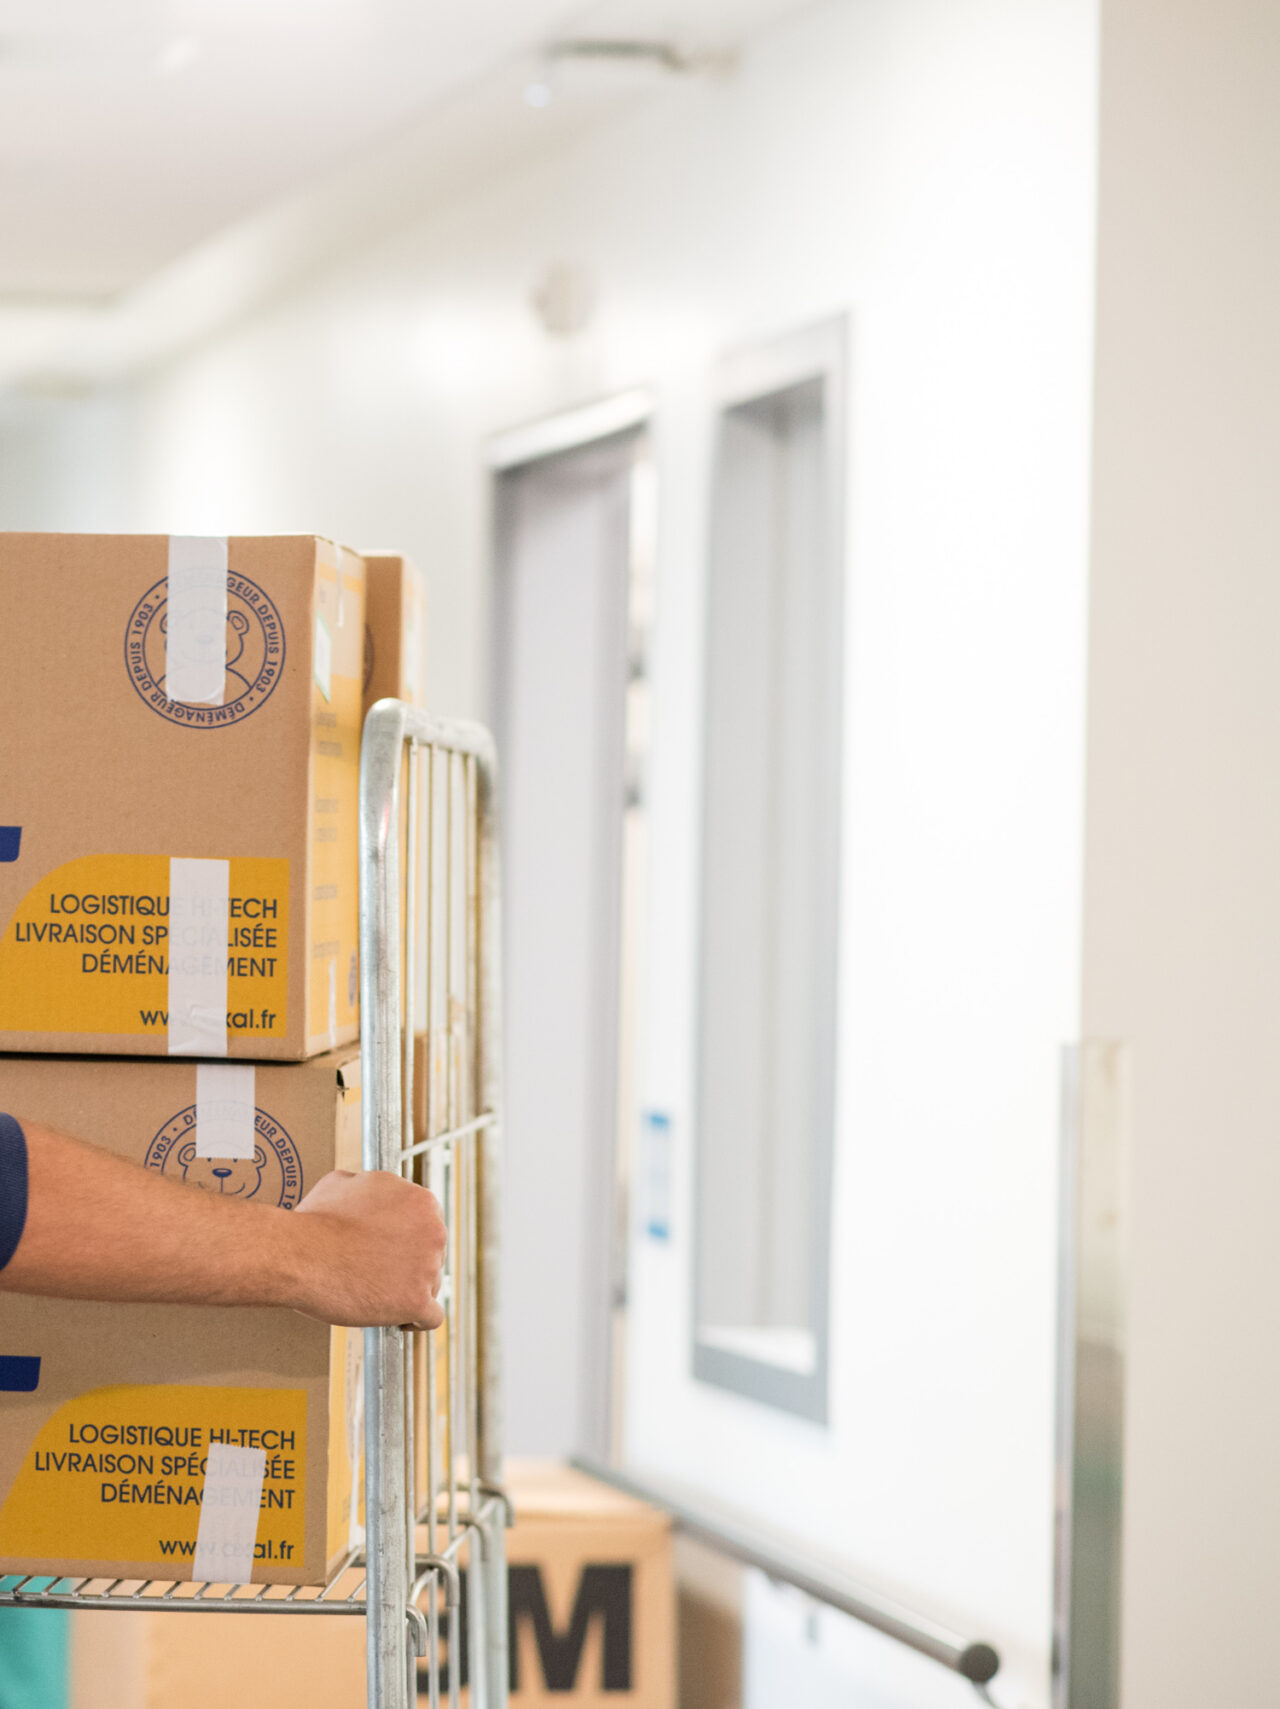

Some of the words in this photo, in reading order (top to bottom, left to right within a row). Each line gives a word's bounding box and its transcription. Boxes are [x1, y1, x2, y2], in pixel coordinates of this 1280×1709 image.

[132, 603, 154, 636] 1903
[258, 604, 280, 654] DEPUIS
[130, 641, 152, 692] DEPUIS
[256, 661, 278, 693] 1903
[50, 893, 184, 918] LOGISTIQU
[15, 922, 136, 945] LIVRAISON
[142, 923, 278, 948] SPISÉE
[82, 949, 278, 977] DÉMÉNENT
[139, 1009, 277, 1030] wal.fr
[149, 1135, 171, 1168] 1903
[275, 1138, 298, 1188] DEPUIS
[69, 1423, 202, 1447] LOGISTIQUE
[209, 1428, 296, 1450] HI-TECH
[35, 1451, 154, 1476] LIVRAISON
[160, 1452, 296, 1480] SPÉSÉE
[101, 1479, 296, 1509] DÉMÉNANT
[159, 1540, 296, 1561] wwal.fr
